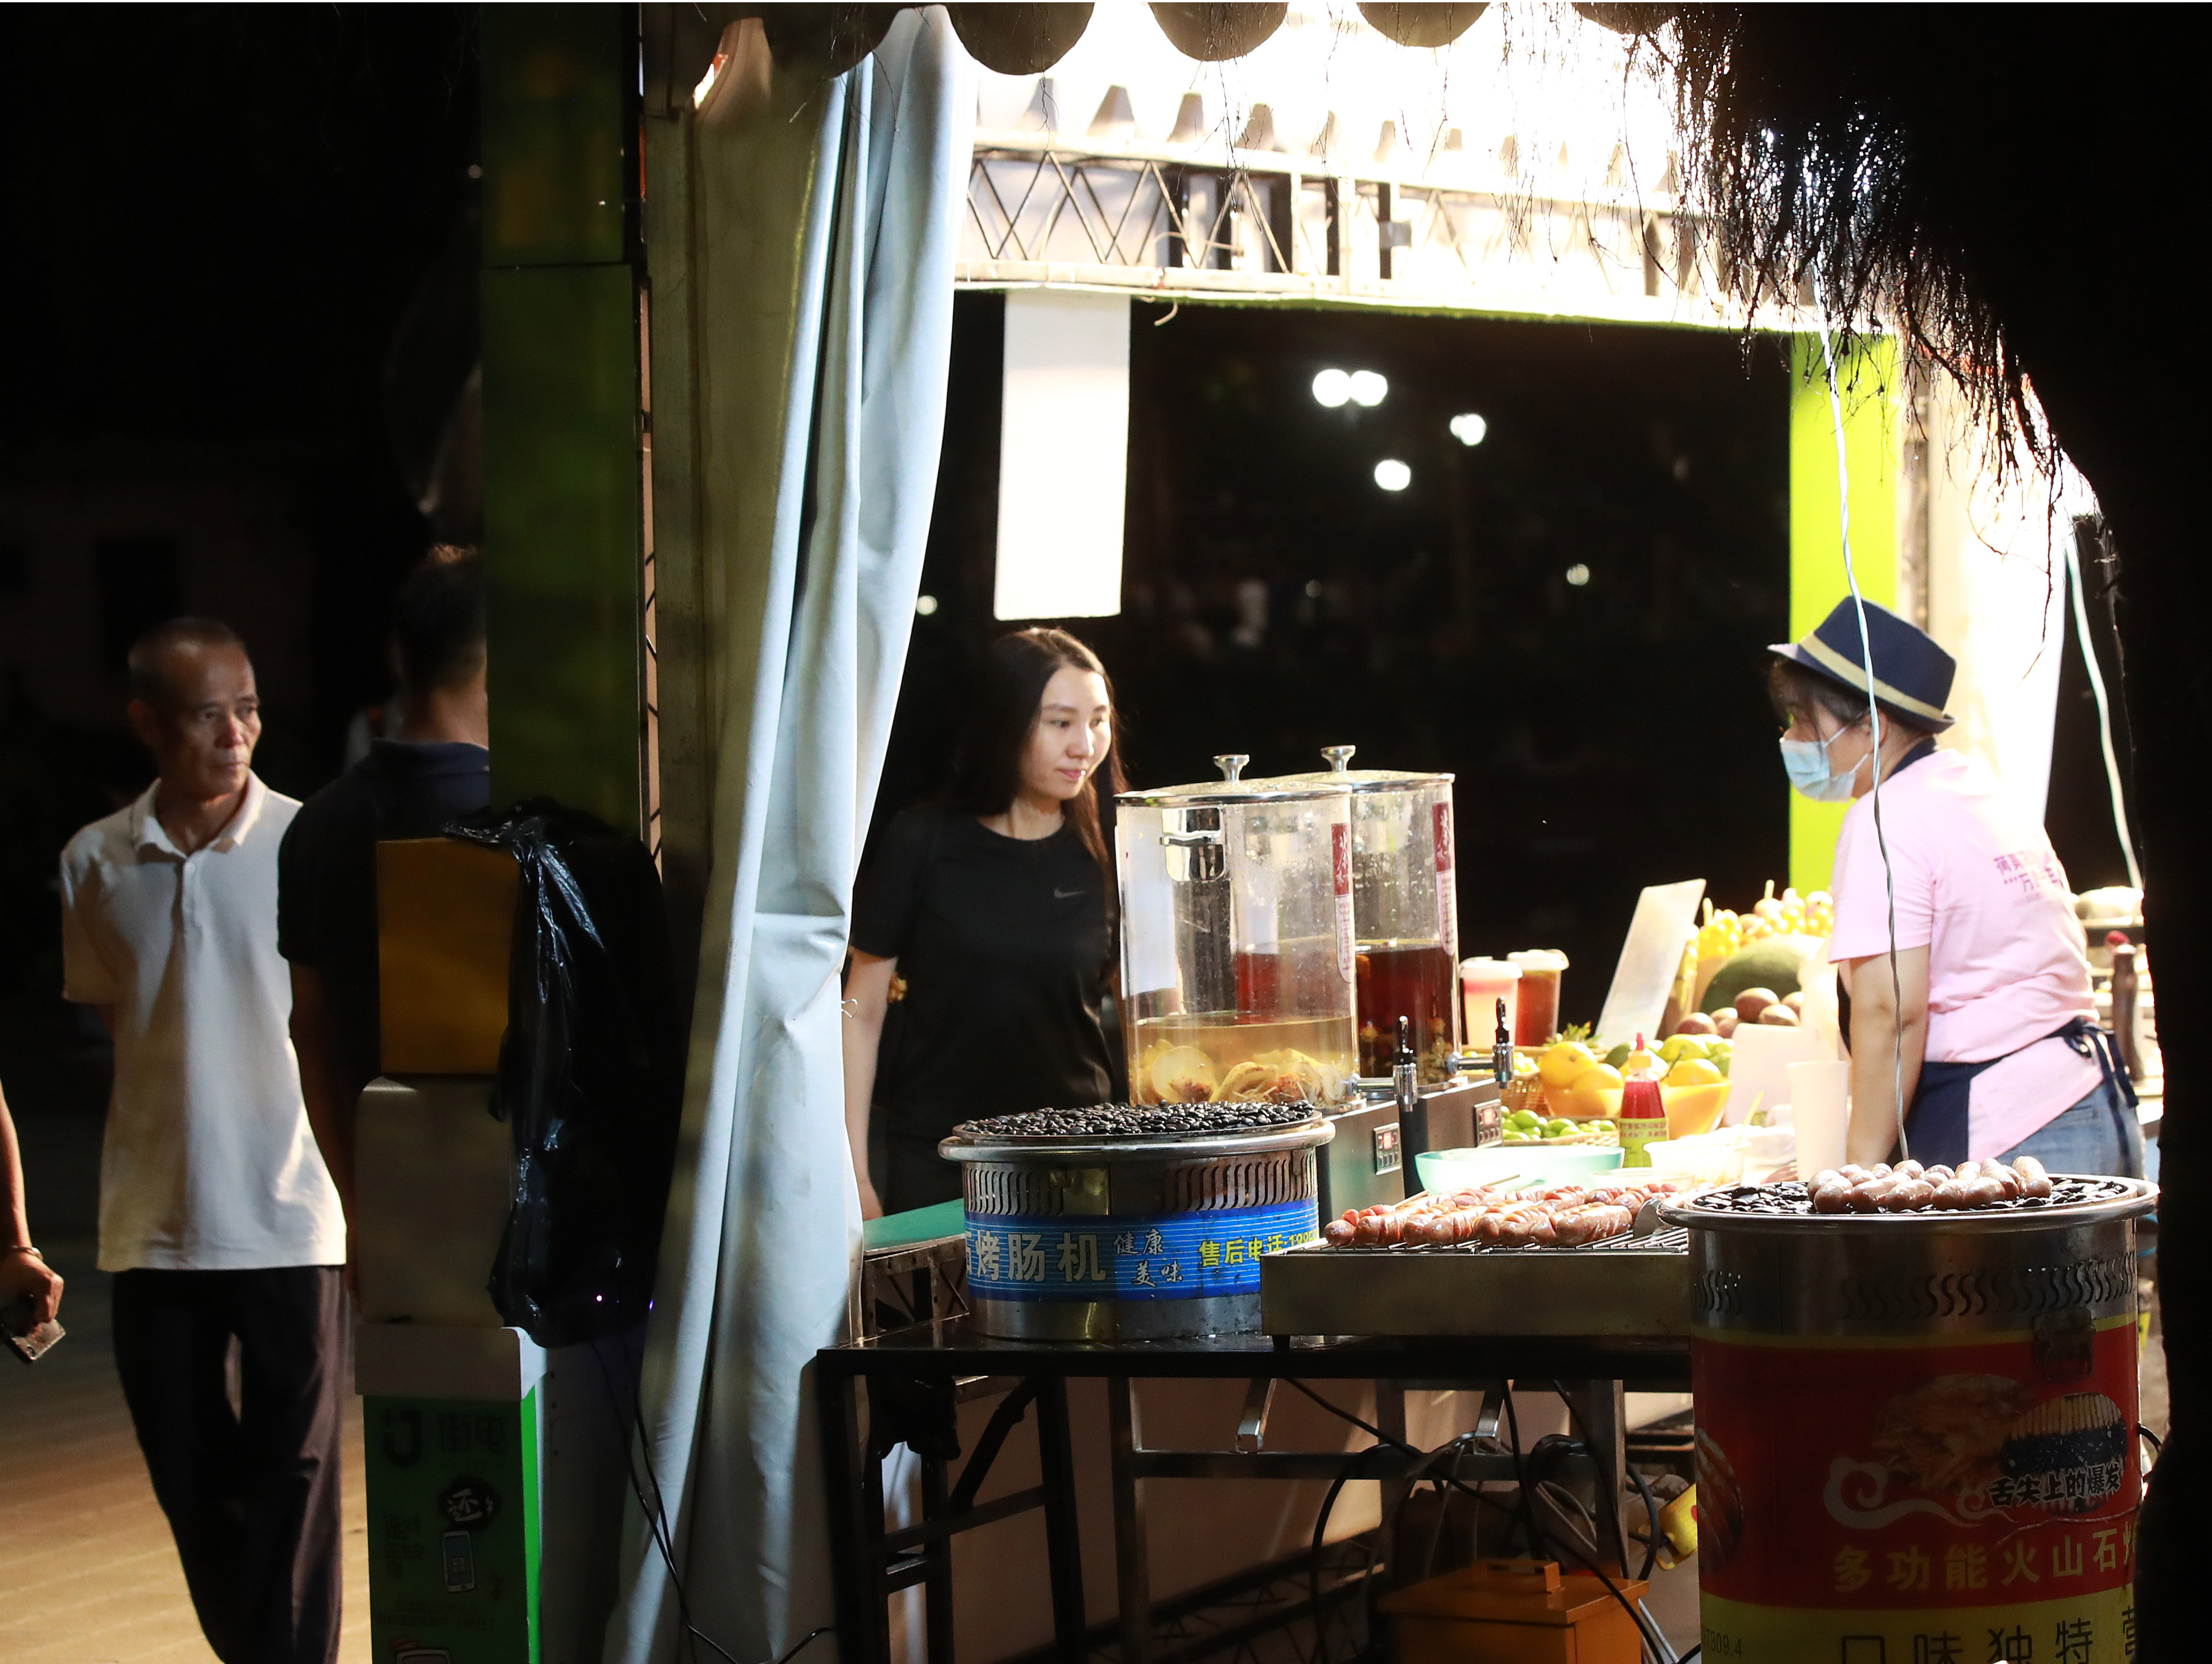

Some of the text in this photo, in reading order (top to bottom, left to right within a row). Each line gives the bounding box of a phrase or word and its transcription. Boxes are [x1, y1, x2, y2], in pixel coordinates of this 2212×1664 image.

[1113, 1228, 1164, 1256] 健康
[1131, 1259, 1184, 1288] 美味
[1989, 1460, 2121, 1507] 舌尖上的爆发
